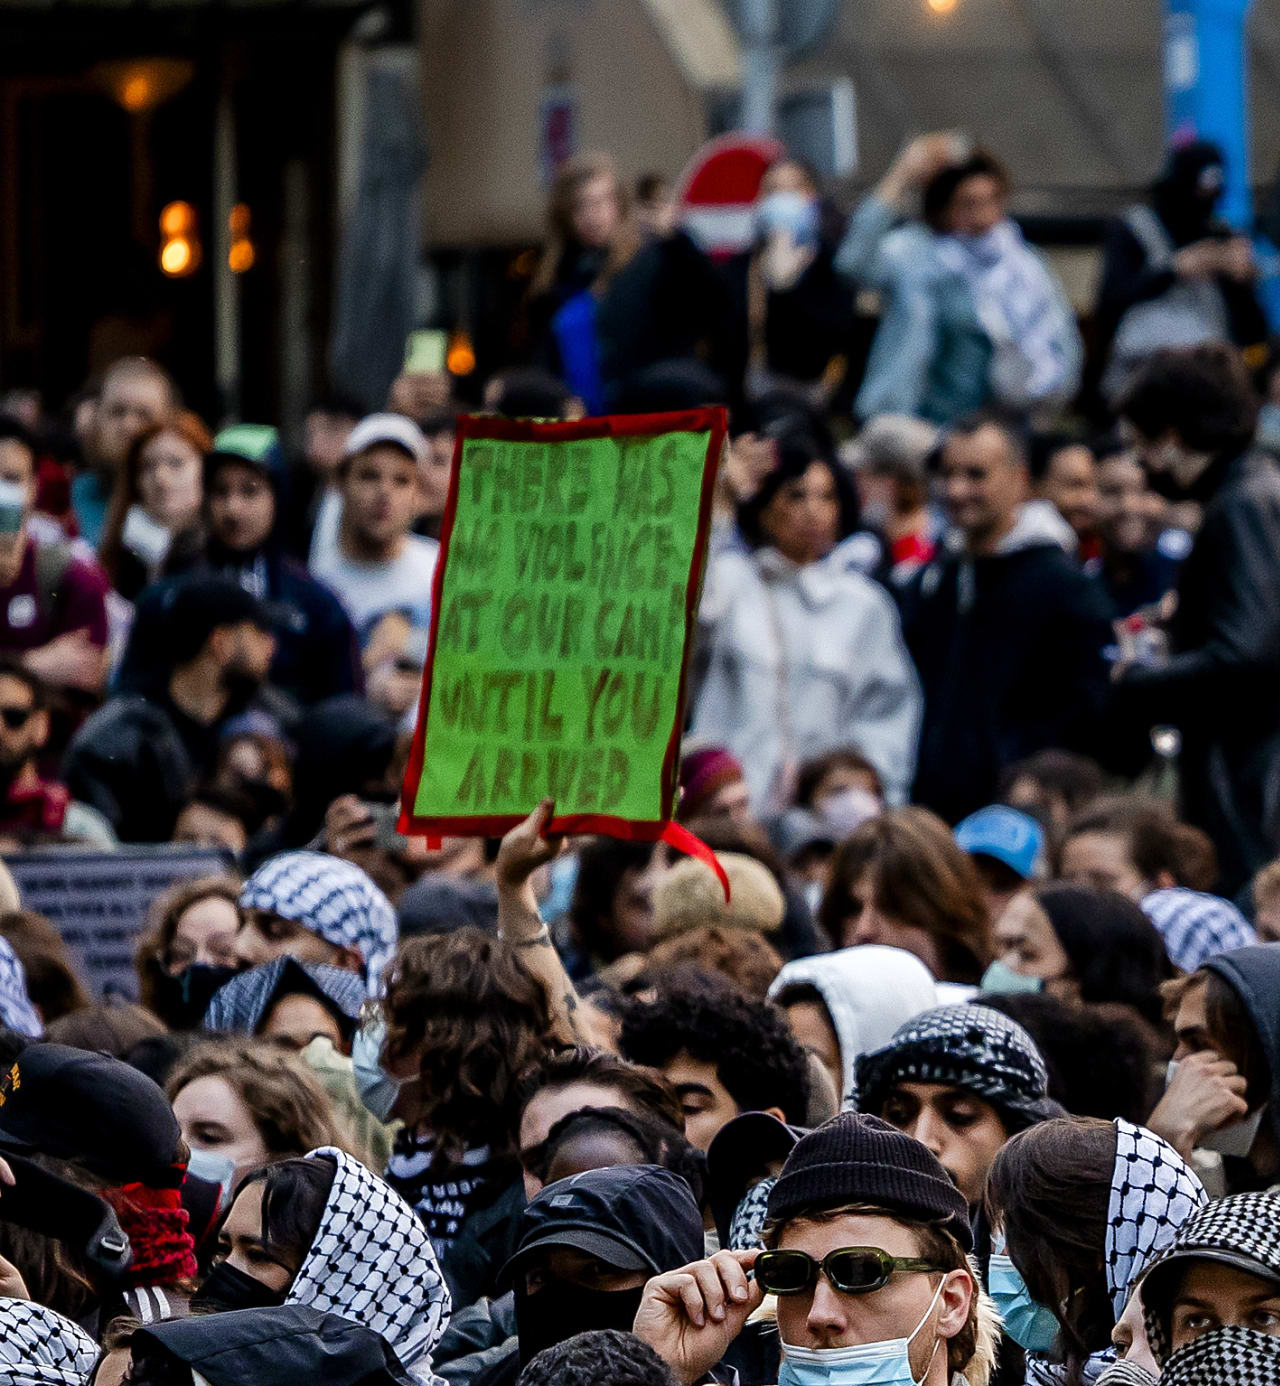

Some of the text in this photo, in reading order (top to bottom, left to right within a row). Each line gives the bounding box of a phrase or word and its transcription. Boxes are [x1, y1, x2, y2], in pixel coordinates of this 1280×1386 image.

[466, 440, 679, 520] THERE WAS
[513, 520, 678, 592] VIOLENCE
[442, 583, 686, 671] AT OUR CAMP
[439, 667, 662, 743] UNTIL YOU
[455, 742, 631, 810] ARRIVED
